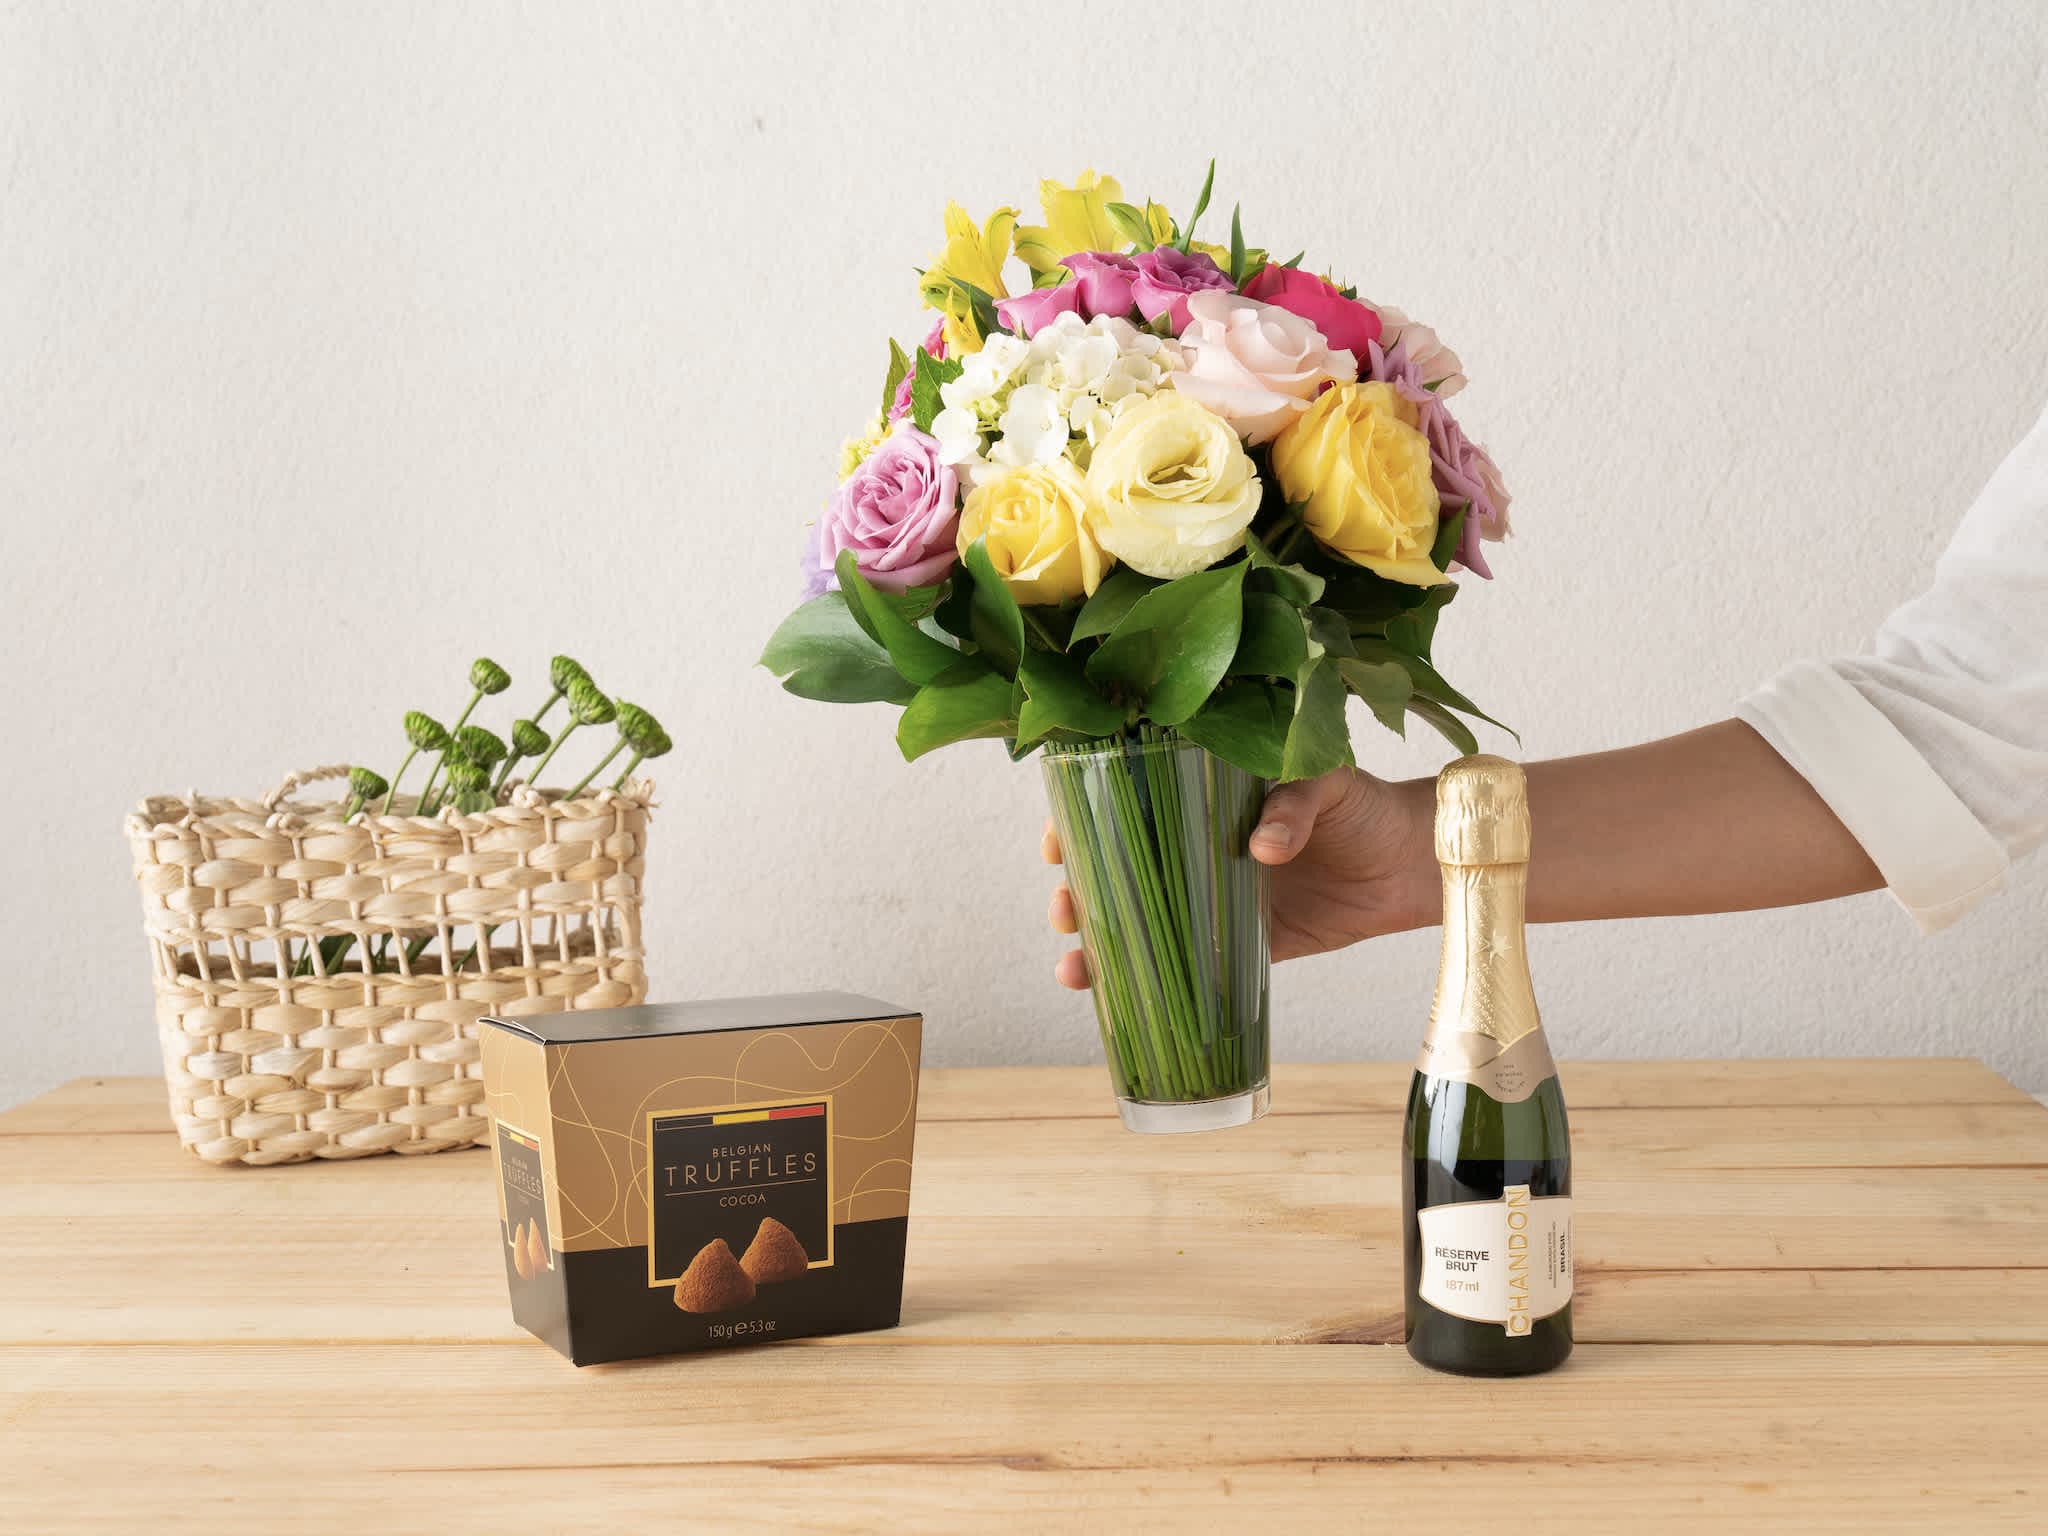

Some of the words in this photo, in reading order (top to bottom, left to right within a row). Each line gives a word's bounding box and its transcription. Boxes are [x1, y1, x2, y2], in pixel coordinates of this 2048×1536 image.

[712, 1143, 771, 1158] BELGIAN
[665, 1152, 817, 1187] TRUFFLES
[719, 1193, 767, 1208] COCOA
[1446, 1261, 1478, 1272] BRUT
[1507, 1189, 1530, 1333] CHANDON
[708, 1324, 725, 1338] 150
[750, 1319, 763, 1334] 5.3
[765, 1320, 777, 1332] oz
